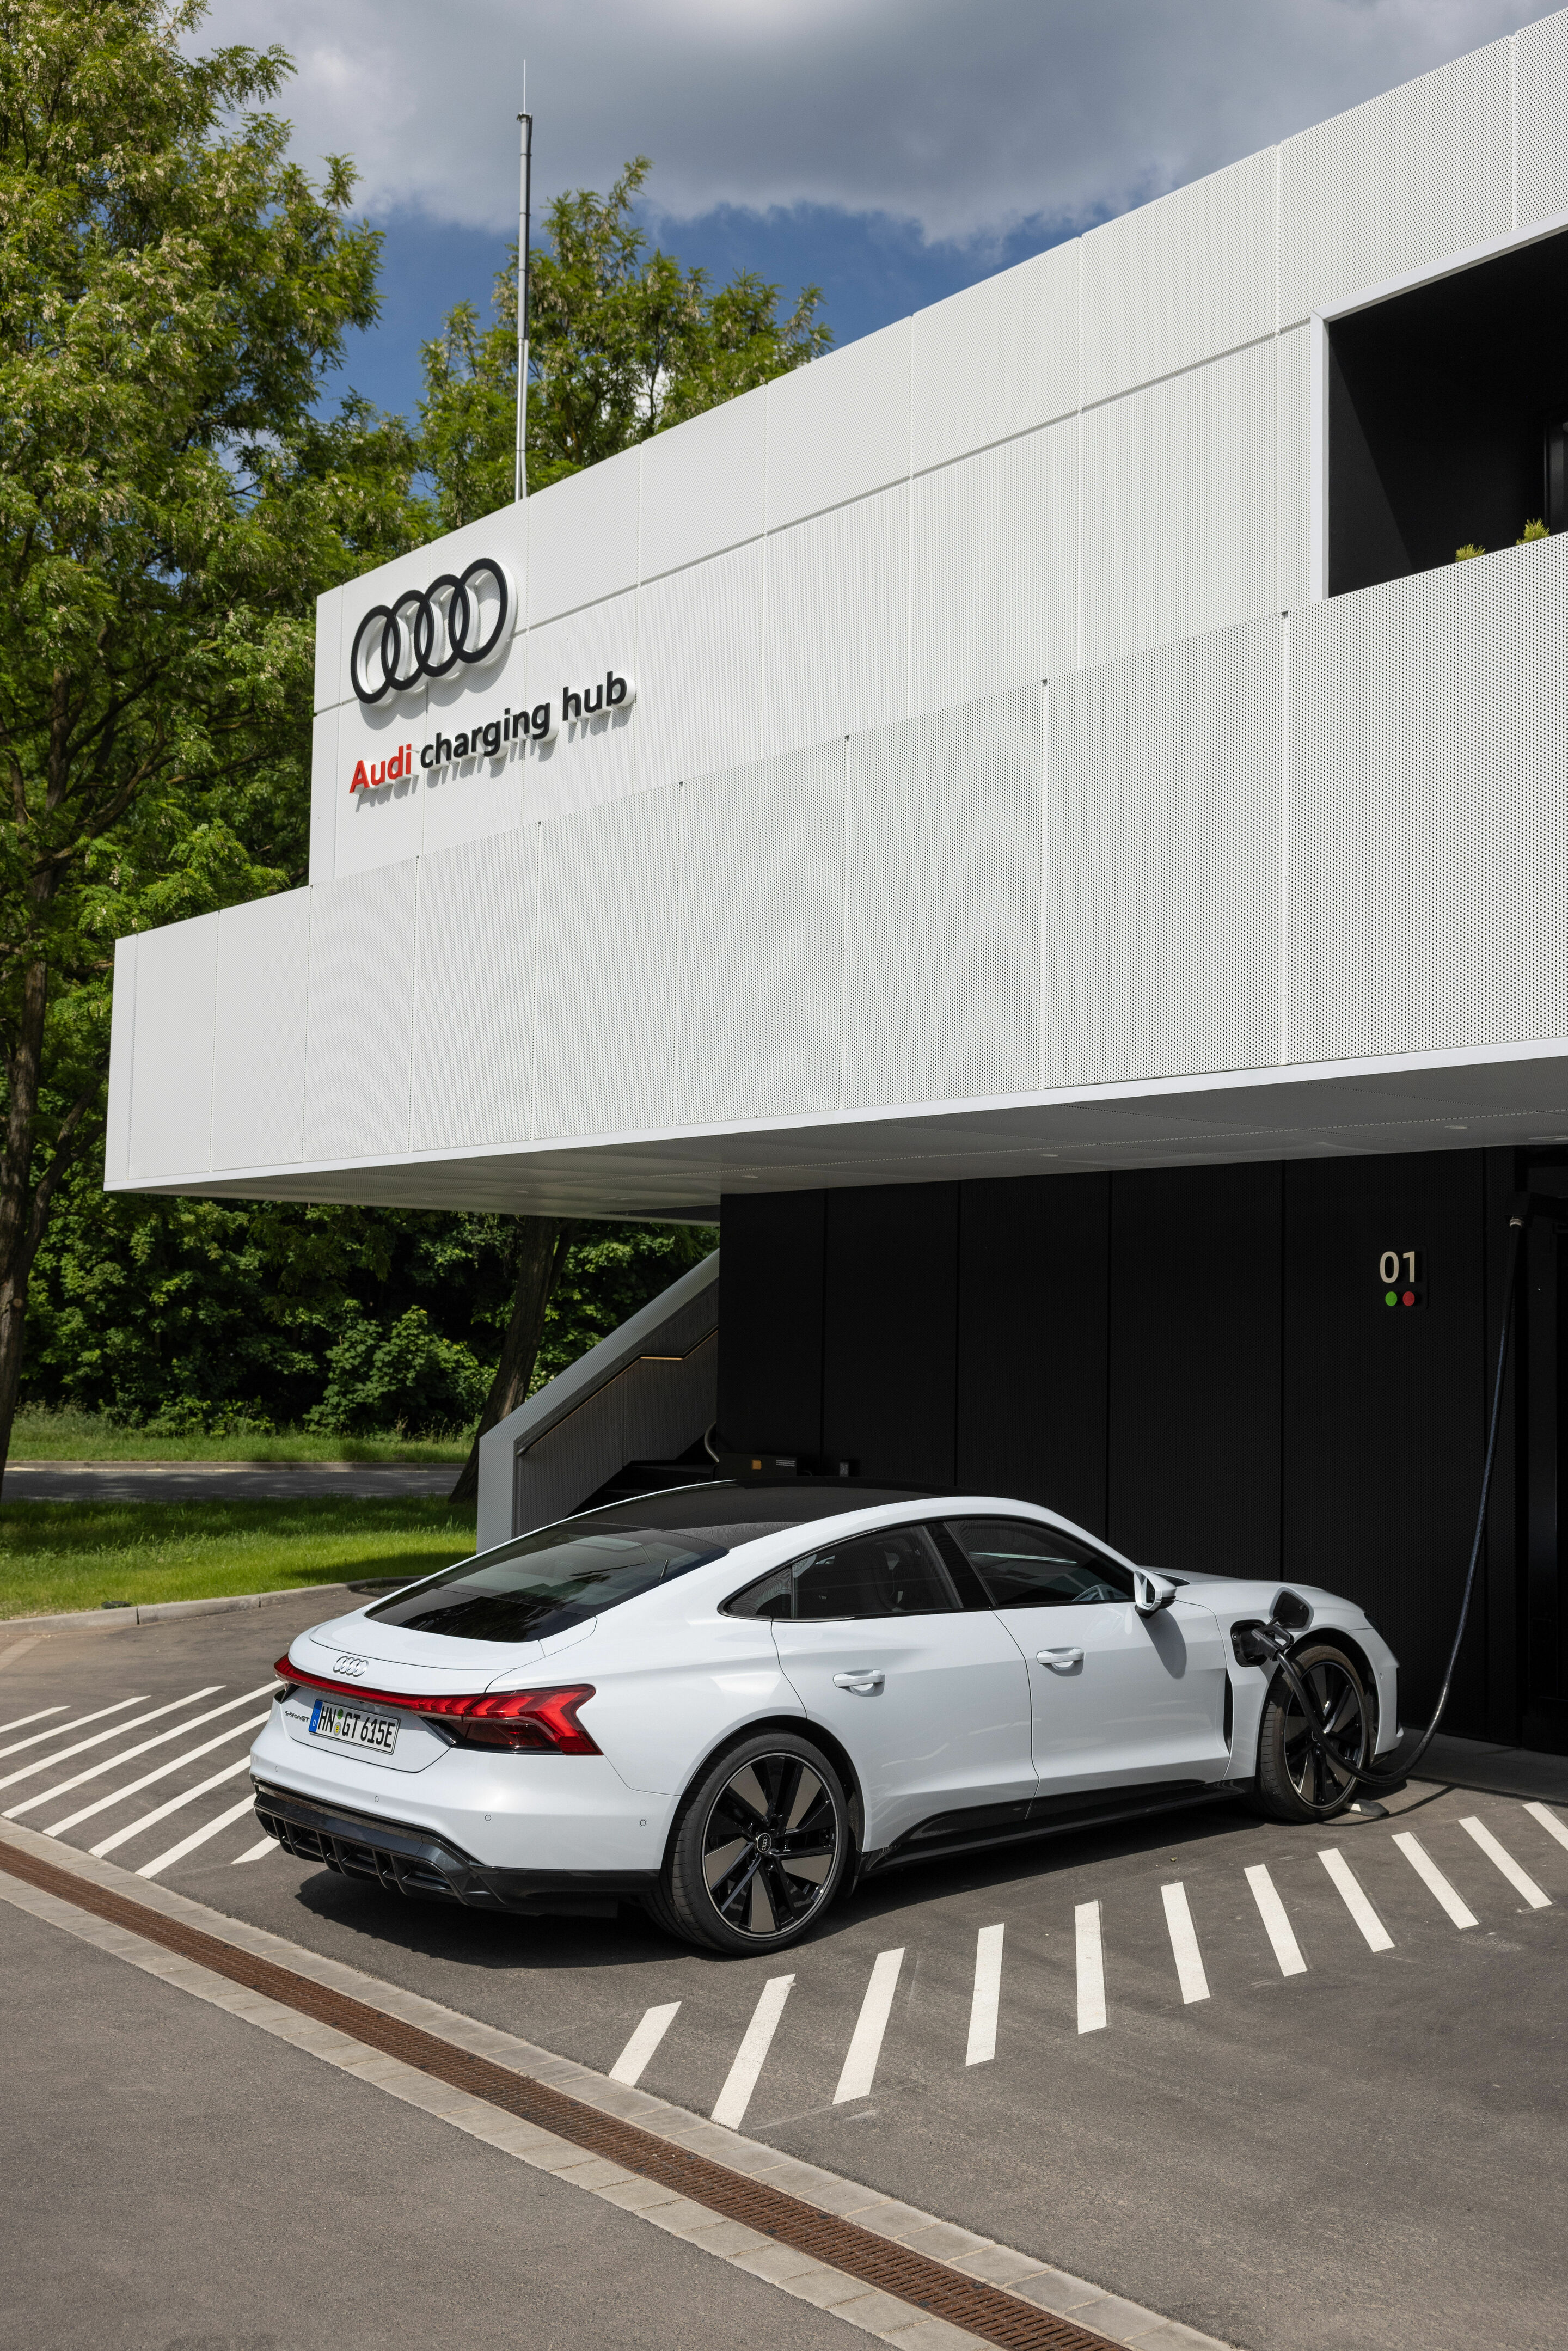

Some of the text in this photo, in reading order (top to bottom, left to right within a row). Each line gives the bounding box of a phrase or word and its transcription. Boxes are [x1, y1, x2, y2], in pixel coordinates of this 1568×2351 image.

[349, 671, 627, 793] Audi charging hub
[1380, 1251, 1415, 1283] 01
[317, 1706, 395, 1748] HN GT 615E
